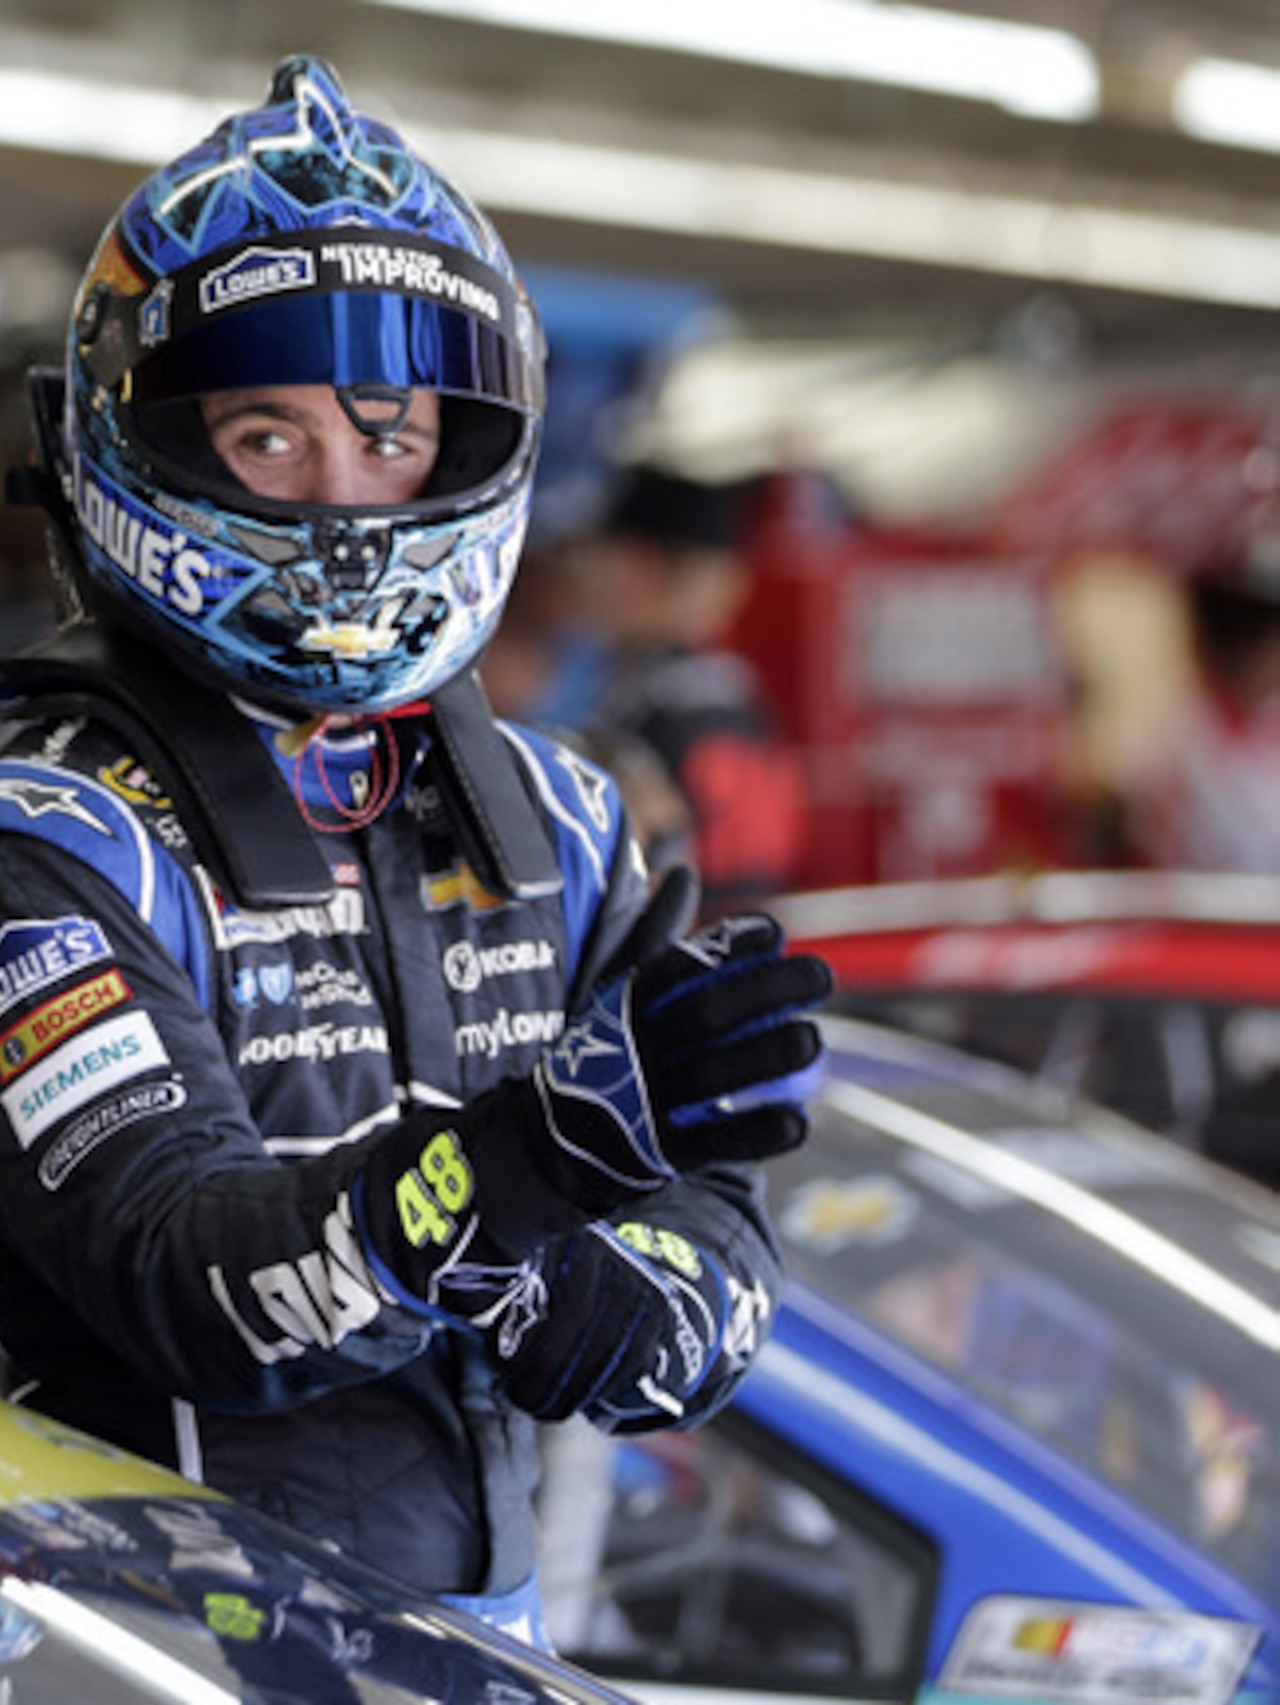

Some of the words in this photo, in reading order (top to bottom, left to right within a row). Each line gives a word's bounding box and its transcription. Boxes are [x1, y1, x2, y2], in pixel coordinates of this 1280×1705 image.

[213, 258, 300, 299] LOWE'S
[341, 252, 501, 322] IMPROVING
[73, 452, 211, 615] LOWE'S
[31, 982, 114, 1044] BOSCH
[237, 1022, 390, 1066] OODYEA
[20, 1033, 142, 1123] SIEMENS
[395, 1128, 475, 1250] 48
